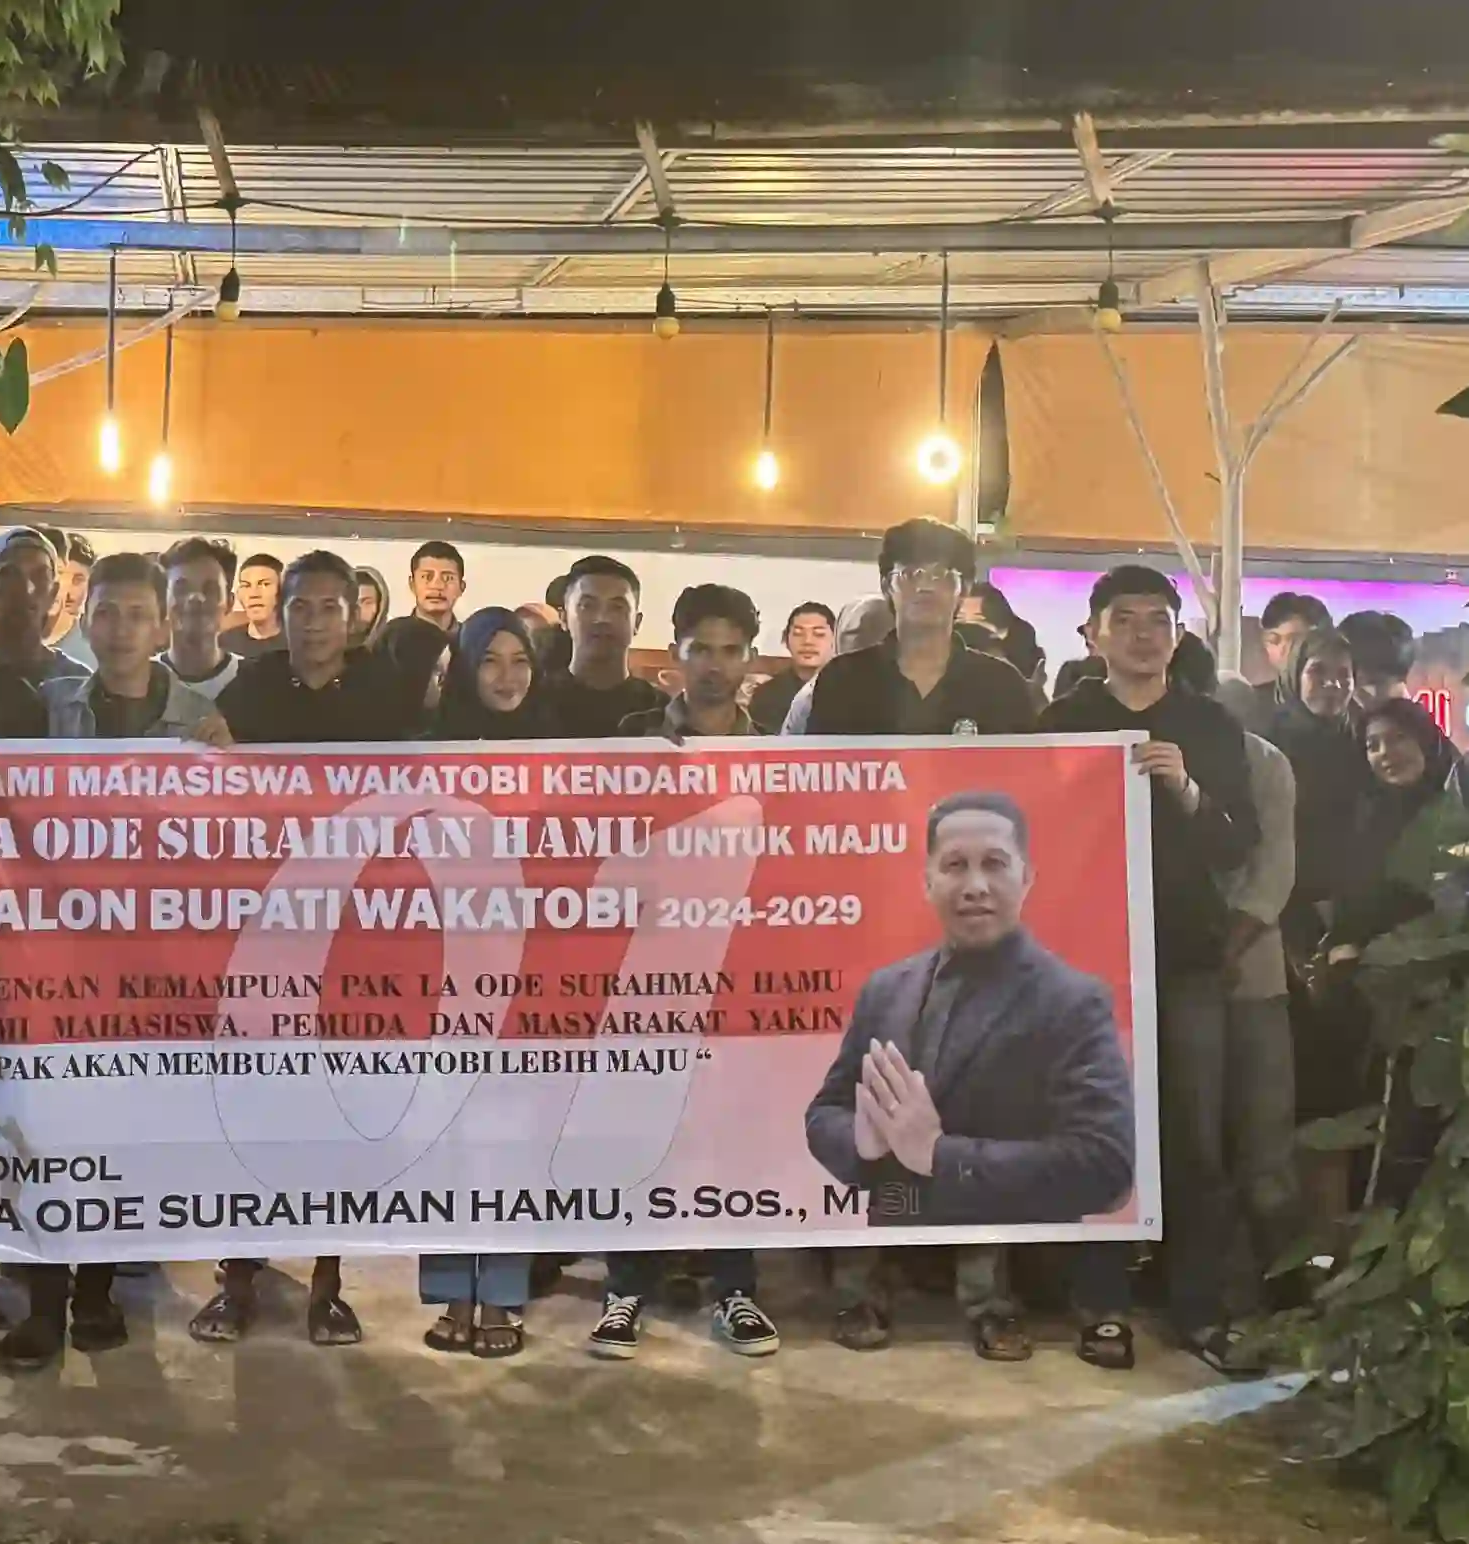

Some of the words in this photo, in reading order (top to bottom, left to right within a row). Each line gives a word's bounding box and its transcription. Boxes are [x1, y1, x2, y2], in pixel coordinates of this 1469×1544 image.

[67, 764, 313, 797] MAHASISWA
[323, 764, 529, 796] WAKATOBI
[541, 763, 718, 796] KENDARI
[731, 761, 907, 794] MEMINTA
[32, 815, 143, 861] ODE
[157, 815, 475, 861] SURAHMAN
[491, 815, 654, 859] HAMU
[667, 824, 795, 858] UNTUK
[804, 822, 907, 856] MAJU
[149, 887, 340, 931] BUPATI
[352, 886, 640, 931] WAKATOBI
[655, 894, 863, 929] 2024-2029
[117, 973, 323, 1000] KEMAMPUAN
[340, 973, 403, 998] PAK
[420, 973, 458, 998] LA
[474, 973, 544, 998] ODE
[559, 971, 735, 998] SURAHMAN
[753, 969, 844, 995] HAMU
[271, 1012, 408, 1038] PEMUDA
[429, 1012, 495, 1037] DAN
[517, 1009, 728, 1036] MASYARAKAT
[748, 1006, 844, 1032] YAKIN
[61, 1052, 151, 1079] AKAN
[156, 1051, 316, 1077] MEMBUAT
[322, 1050, 492, 1076] WAKATOBI
[499, 1049, 599, 1075] LEBIH
[36, 1196, 145, 1232] ODE
[158, 1189, 455, 1229] SURAHMAN
[470, 1188, 634, 1226] HAMU,
